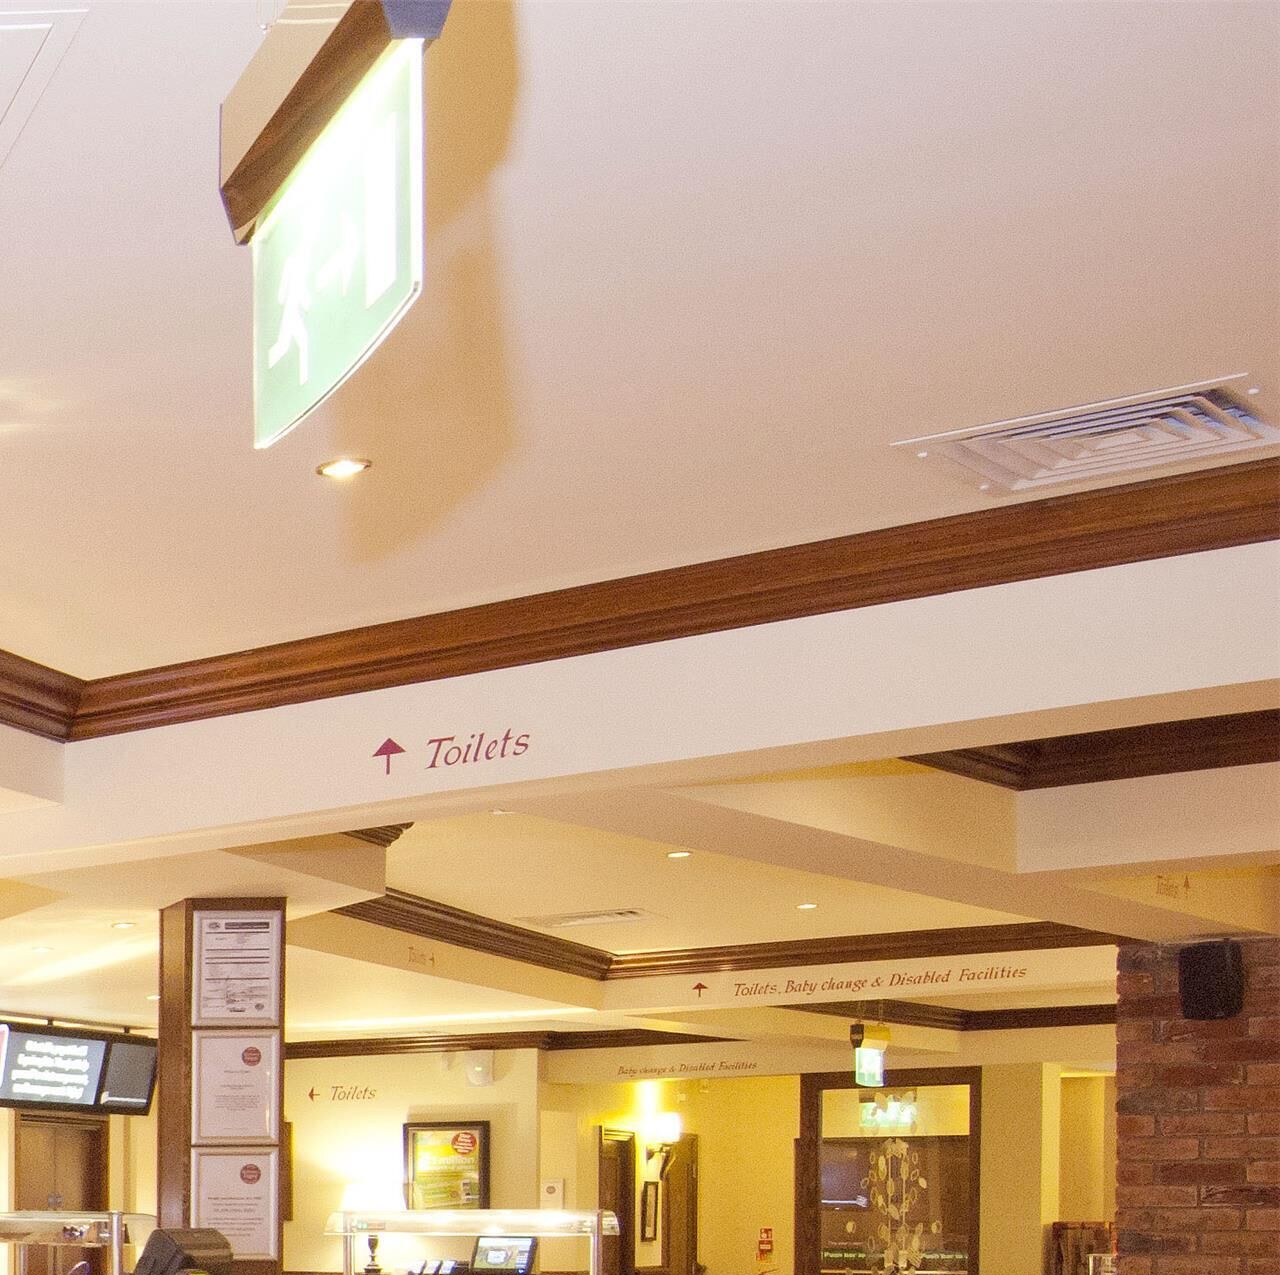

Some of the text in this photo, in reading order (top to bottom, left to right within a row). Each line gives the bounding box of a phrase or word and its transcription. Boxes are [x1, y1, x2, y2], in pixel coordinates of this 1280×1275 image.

[425, 728, 531, 769] Toilets
[785, 979, 818, 996] Baby
[821, 977, 867, 992] change
[871, 976, 884, 988] &
[889, 969, 951, 987] Disabled
[958, 966, 1028, 982] Facilities
[718, 1060, 759, 1071] Facilities
[331, 1085, 378, 1101] Toilets
